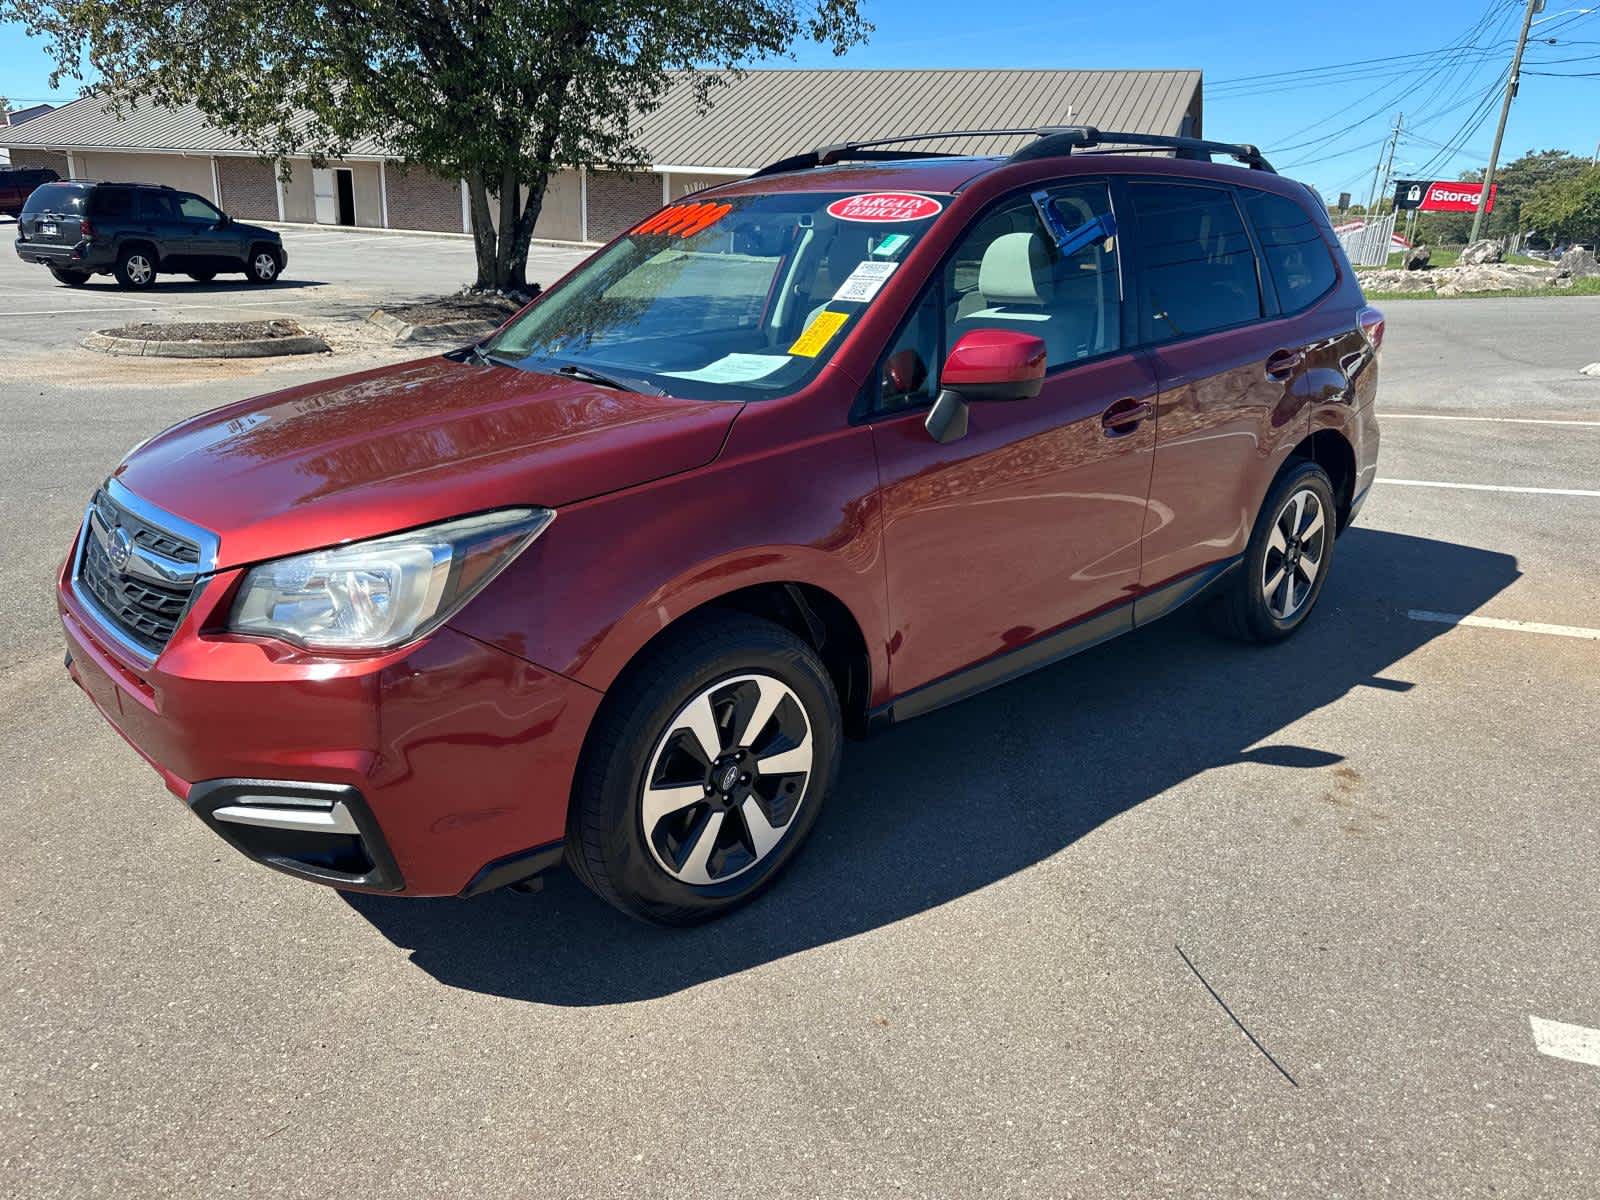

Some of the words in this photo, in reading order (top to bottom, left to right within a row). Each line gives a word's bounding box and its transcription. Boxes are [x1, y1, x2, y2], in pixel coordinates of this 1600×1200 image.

[847, 196, 928, 209] BARGAIN
[1431, 189, 1482, 205] iStorag
[840, 206, 918, 219] VEHICLE
